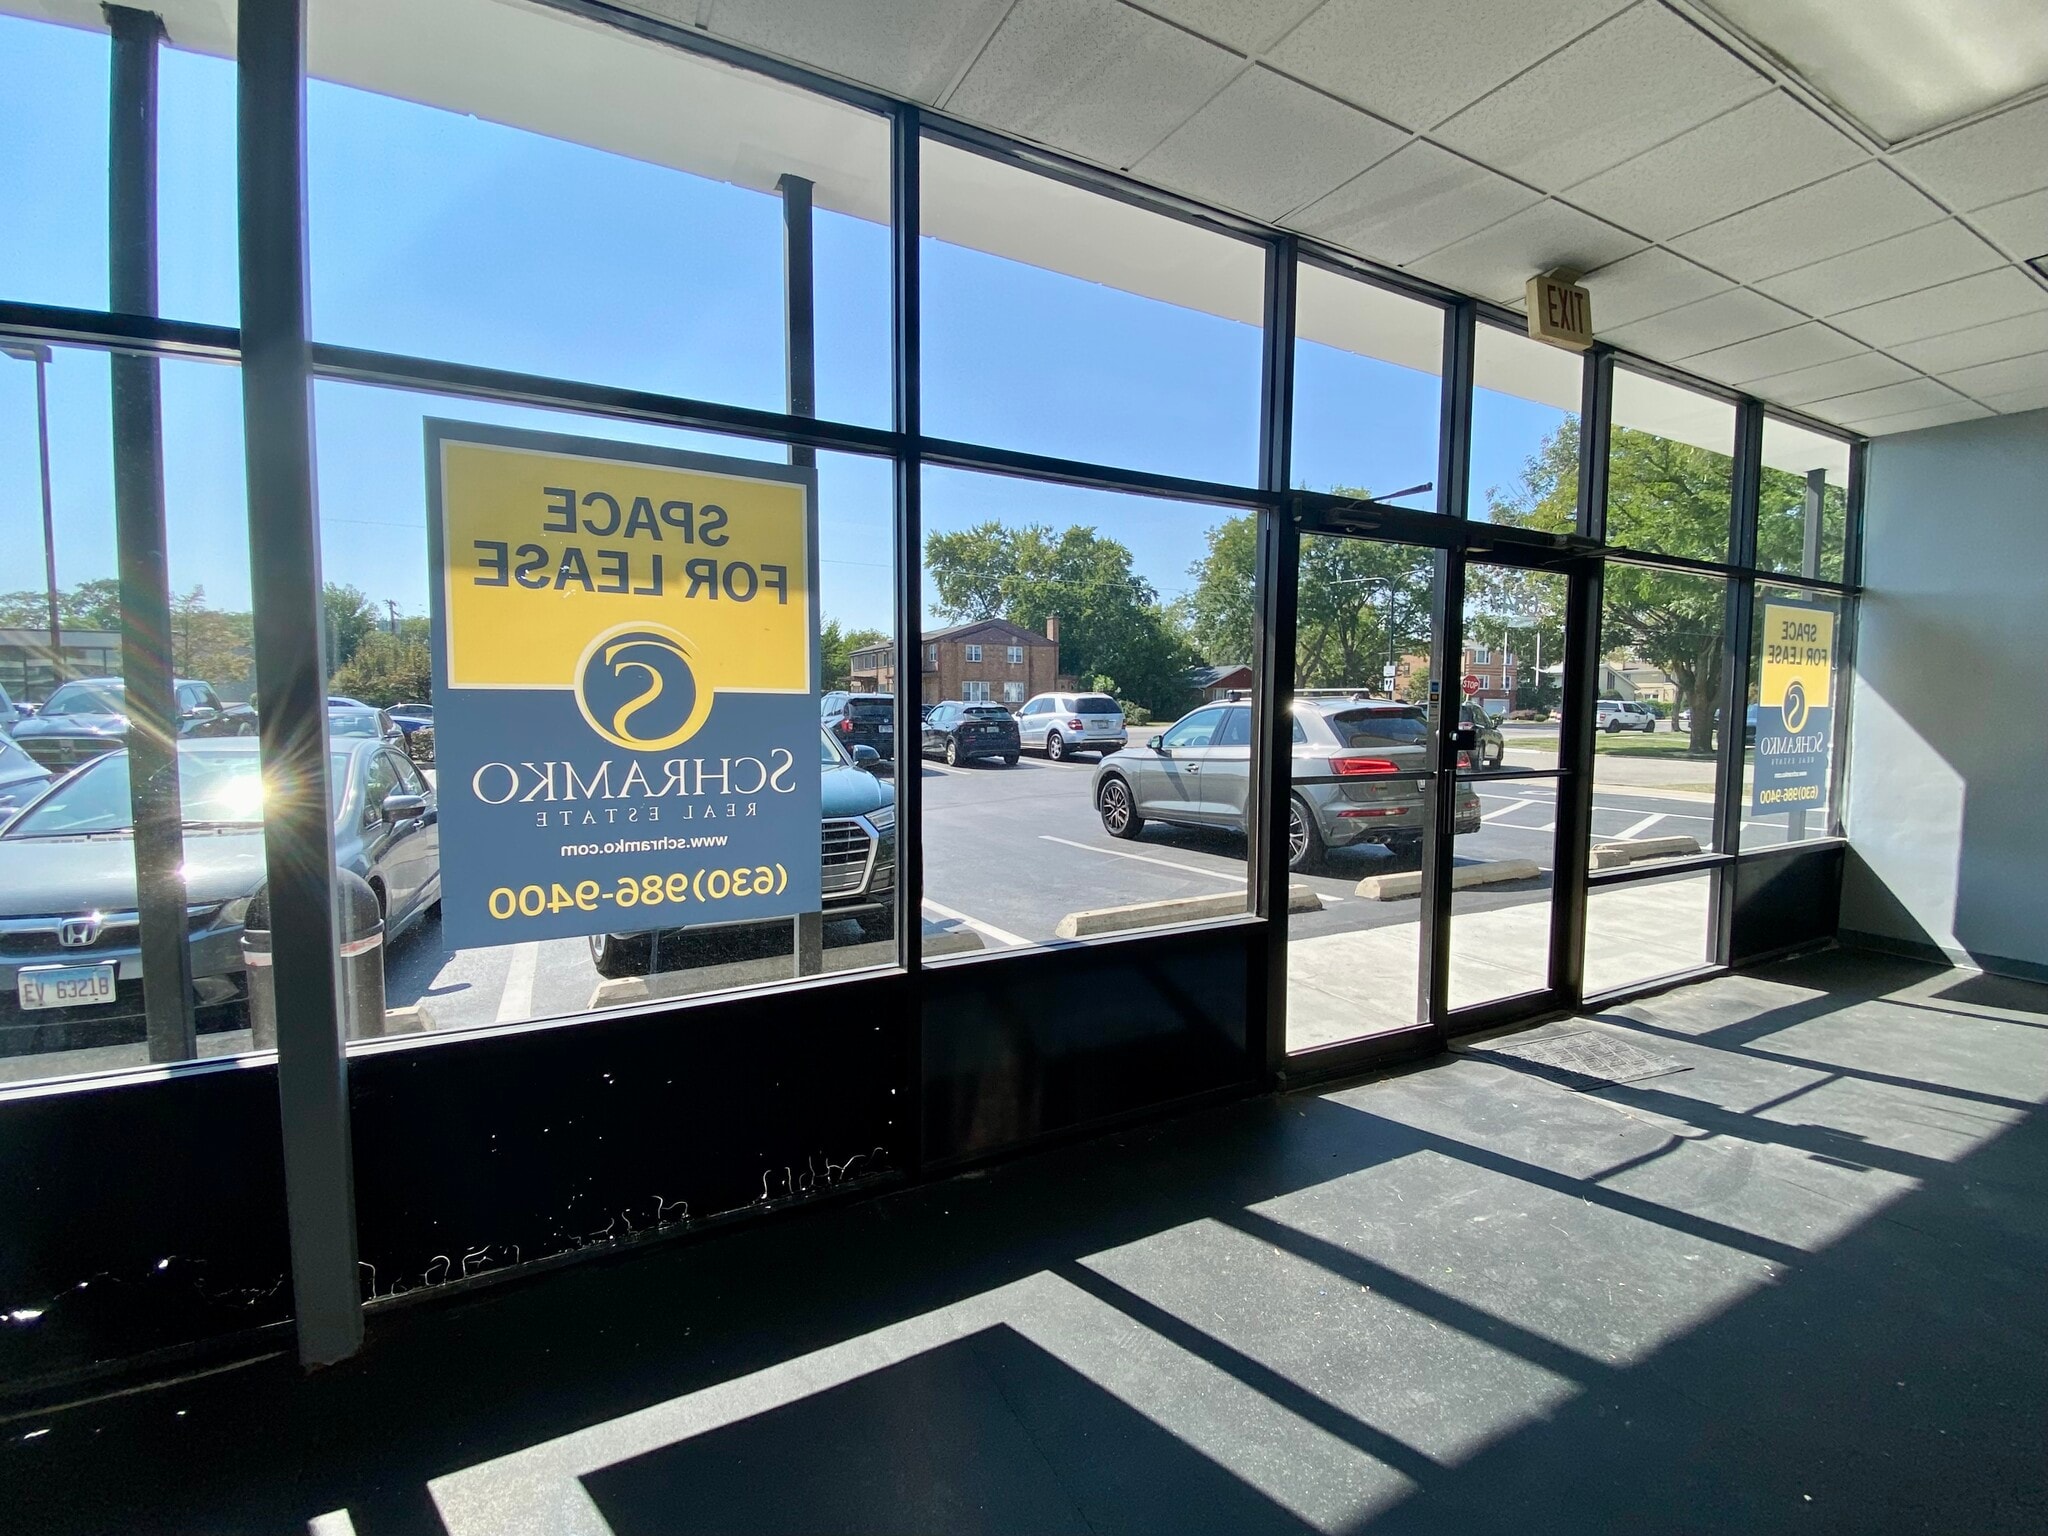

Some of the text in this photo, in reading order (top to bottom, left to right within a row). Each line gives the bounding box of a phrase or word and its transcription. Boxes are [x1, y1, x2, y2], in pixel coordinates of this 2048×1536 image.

[1547, 284, 1583, 334] EXIT
[1463, 680, 1479, 690] STOP
[24, 982, 45, 1003] EV
